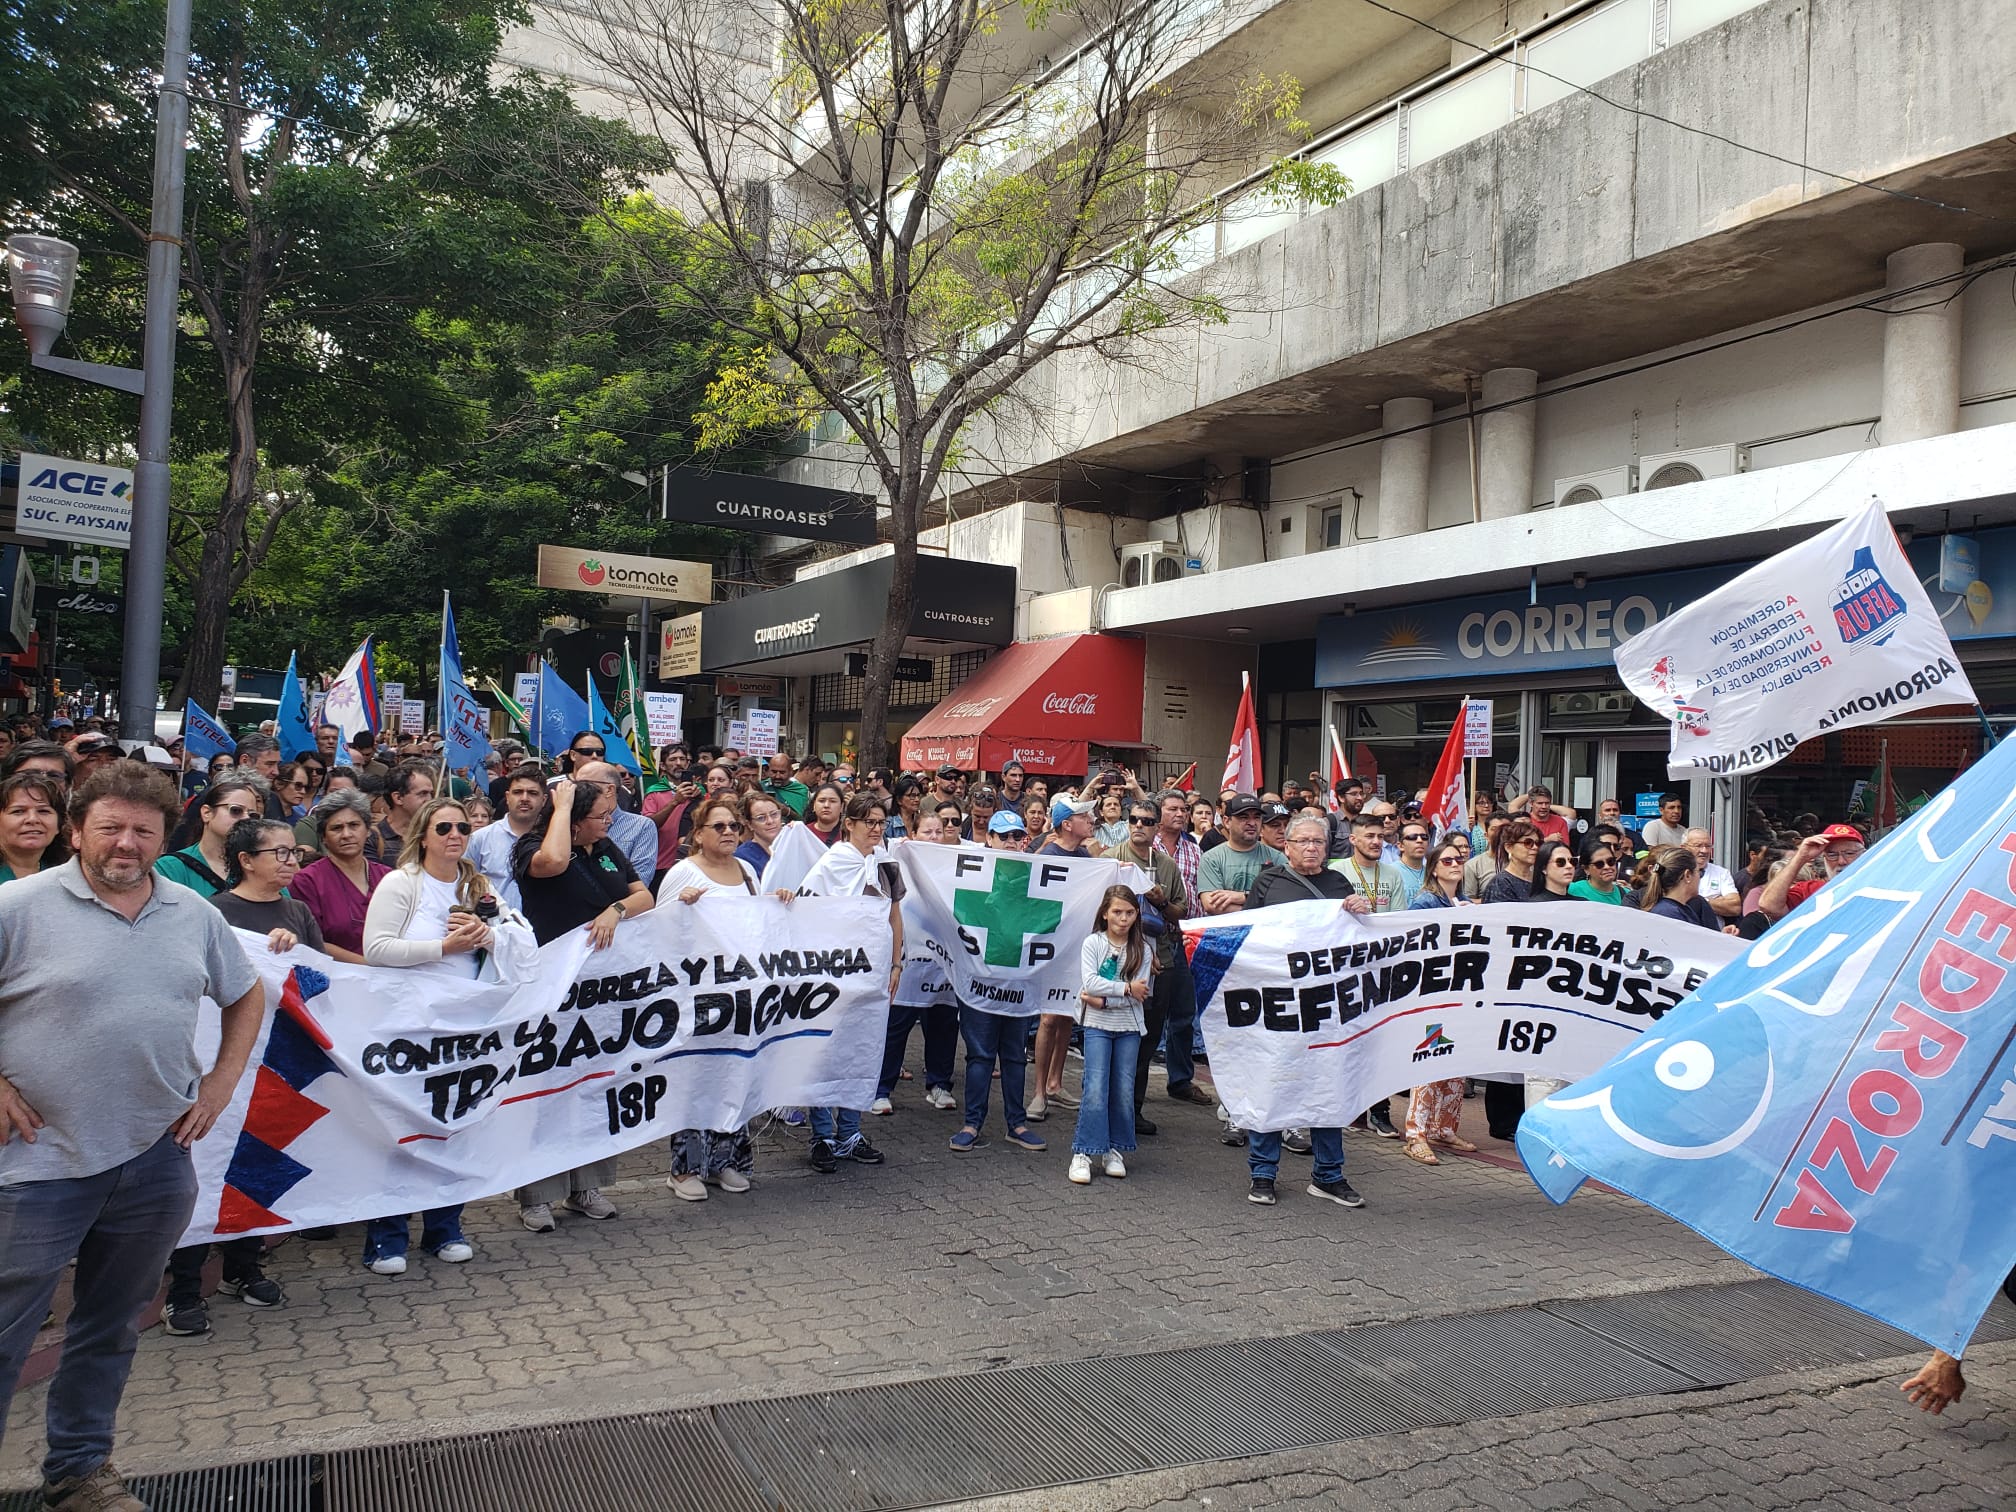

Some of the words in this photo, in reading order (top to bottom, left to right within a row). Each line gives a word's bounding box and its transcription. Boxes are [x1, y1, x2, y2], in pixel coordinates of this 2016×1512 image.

[27, 469, 108, 496] ACE
[23, 508, 59, 523] SUC.
[65, 514, 131, 533] PAYSAN
[27, 495, 71, 507] ASOCIACION
[73, 501, 119, 513] COOPERATIVA
[608, 565, 679, 587] tomate
[674, 623, 697, 641] tomate
[1457, 595, 1658, 659] CORREO
[648, 695, 678, 703] ambev
[189, 715, 229, 748] SUTEL
[955, 853, 984, 878] F
[1039, 863, 1070, 887] F
[957, 924, 981, 956] S
[1028, 942, 1055, 966] P
[1287, 922, 1440, 980] DEFENDER
[1449, 923, 1491, 946] EL
[1506, 925, 1675, 980] TRABAJO
[693, 981, 841, 1037] DIGNO
[970, 979, 1024, 1005] PAYSANDU
[1047, 988, 1070, 1000] PIT
[1222, 951, 1490, 1033] DEFENDER
[361, 1030, 503, 1075] CONTRA
[680, 957, 708, 986] Y
[714, 953, 759, 985] LA
[758, 947, 873, 980] VIOLENCIA
[1497, 1018, 1557, 1055] ISP
[605, 1074, 668, 1135] ISP
